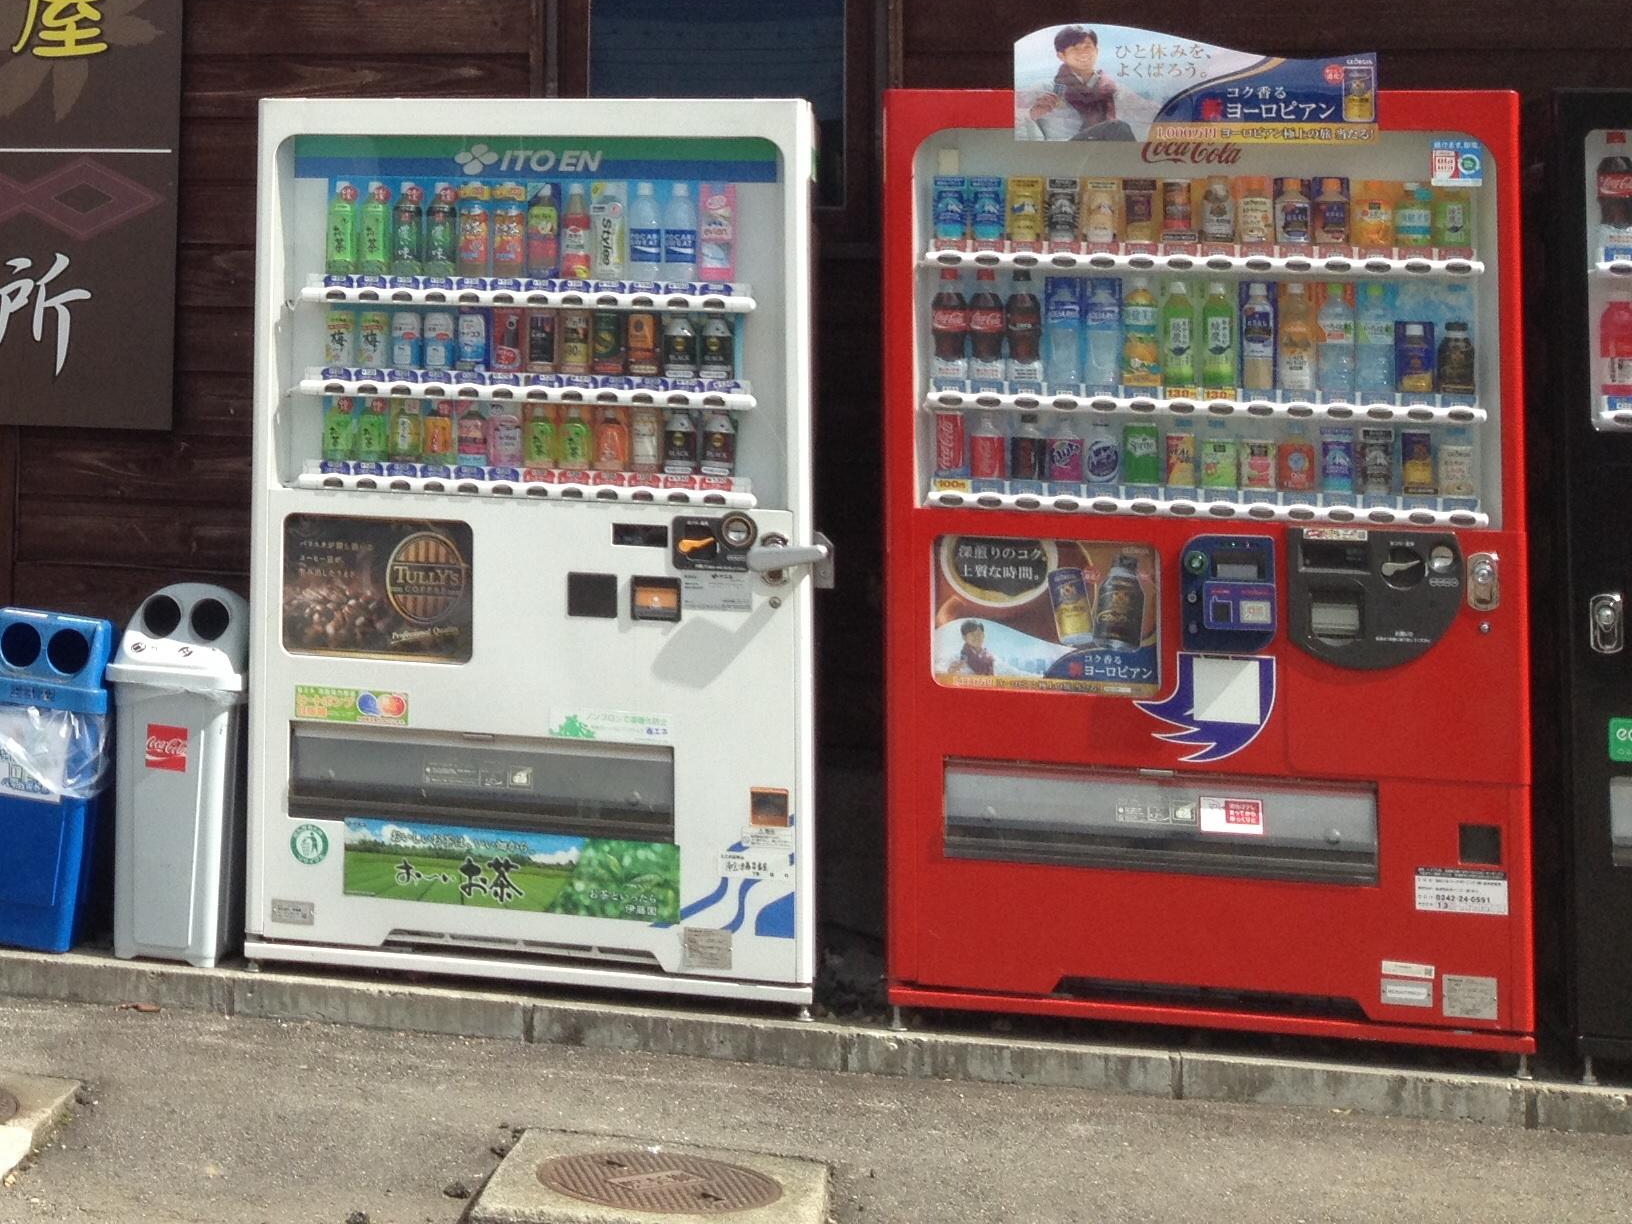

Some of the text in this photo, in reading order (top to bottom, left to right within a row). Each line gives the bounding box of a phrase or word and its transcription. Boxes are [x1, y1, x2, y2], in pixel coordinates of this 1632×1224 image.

[1226, 85, 1288, 99] コク香る
[1226, 100, 1336, 120] ヨーロピアン
[500, 150, 602, 172] ITO EN
[957, 544, 1049, 563] 深煎りのコク。
[962, 563, 1041, 581] 上質な時間。
[1083, 665, 1154, 680] ヨーロピアン
[589, 888, 658, 905] お茶といったら
[625, 904, 658, 917] 伊藤園
